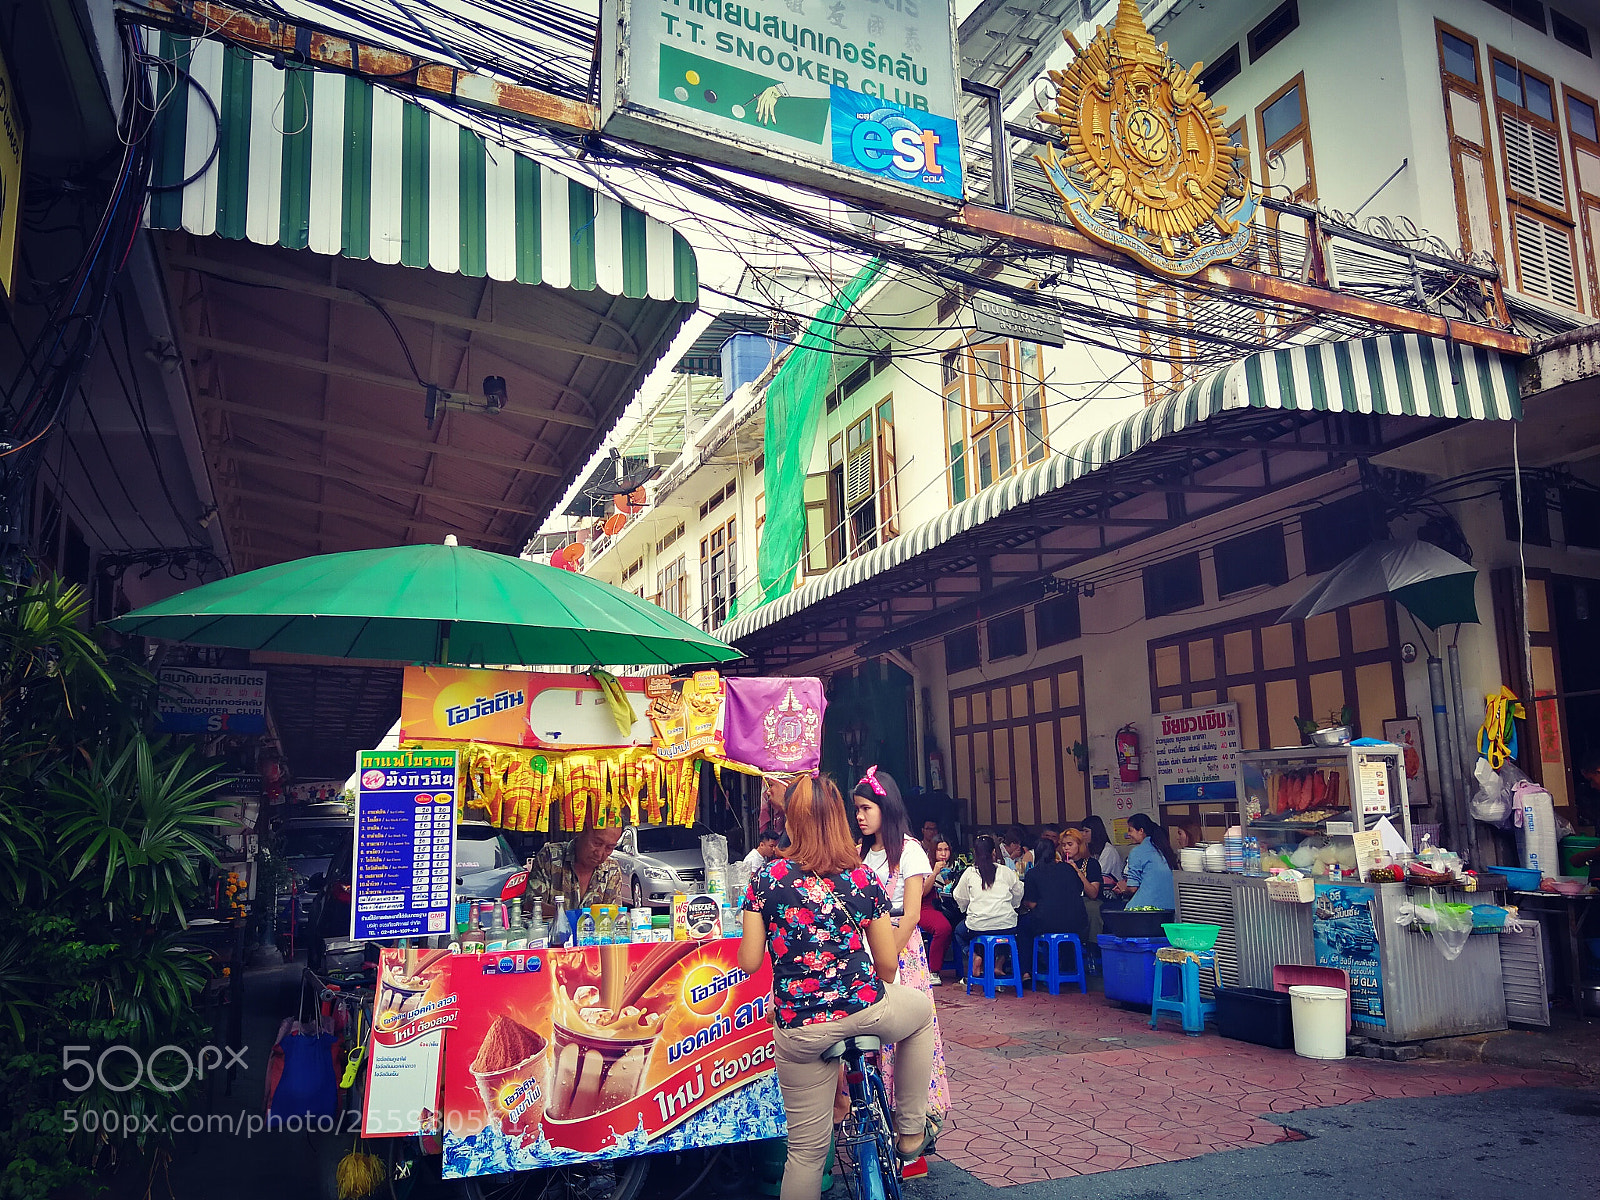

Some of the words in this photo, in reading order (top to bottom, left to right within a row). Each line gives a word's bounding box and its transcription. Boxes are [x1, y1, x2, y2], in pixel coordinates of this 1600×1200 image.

[661, 11, 706, 45] T.T.
[715, 31, 849, 89] SNOOKER
[852, 120, 942, 174] est
[922, 175, 945, 183] COLA
[445, 690, 524, 726] โอวัลติน
[1162, 710, 1226, 736] ชัยชวนชิม
[362, 752, 454, 767] กาแฟโบราณ
[690, 968, 750, 1004] โอวัลติน
[1361, 978, 1378, 987] GLA
[407, 1002, 435, 1019] มอคค่า
[437, 994, 457, 1008] ลาวา
[393, 1023, 415, 1042] ใหม่
[417, 1011, 458, 1032] ต้องลอง!
[667, 1014, 731, 1064] มอคค่า
[504, 1078, 536, 1106] โอวัลติน
[509, 1086, 541, 1122] ภูเขาไฟ
[653, 1064, 705, 1122] ใหม่
